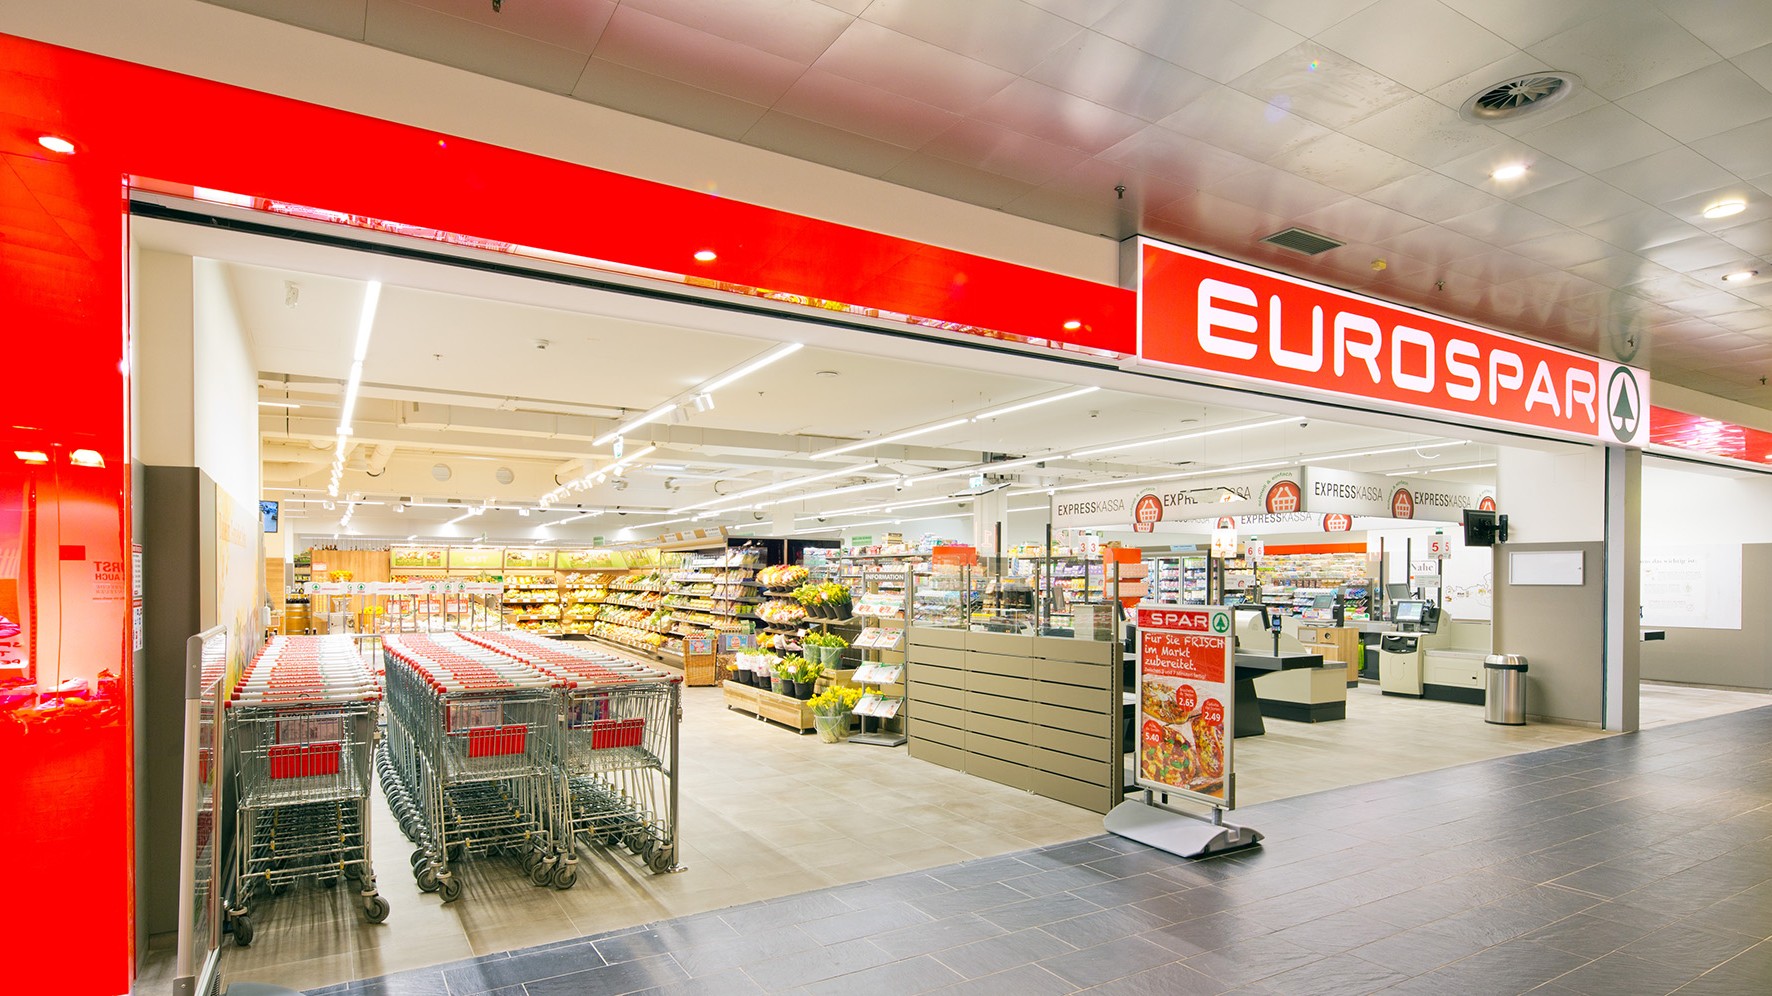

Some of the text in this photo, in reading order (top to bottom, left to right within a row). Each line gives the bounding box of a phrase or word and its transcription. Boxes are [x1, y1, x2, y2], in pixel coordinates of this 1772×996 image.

[1197, 277, 1596, 423] EUROSPAR
[1315, 482, 1384, 502] EXPRESSKASSA
[1414, 491, 1471, 509] EXPRESSKASSA
[1058, 499, 1125, 516] EXPRESSKASSA
[1080, 543, 1086, 552] 3
[1090, 543, 1096, 552] 3
[1247, 547, 1253, 555] 6
[1257, 547, 1262, 555] 6
[1431, 542, 1439, 552] 5
[1445, 542, 1449, 551] 5
[1151, 613, 1208, 628] SPAR
[1144, 633, 1225, 649] Für Sie FRISCH
[1144, 645, 1190, 658] im Markt
[1145, 655, 1197, 671] zubereitet.
[1179, 698, 1194, 707] 2.65
[1204, 712, 1221, 721] 2.49
[1145, 732, 1160, 742] 5.40
